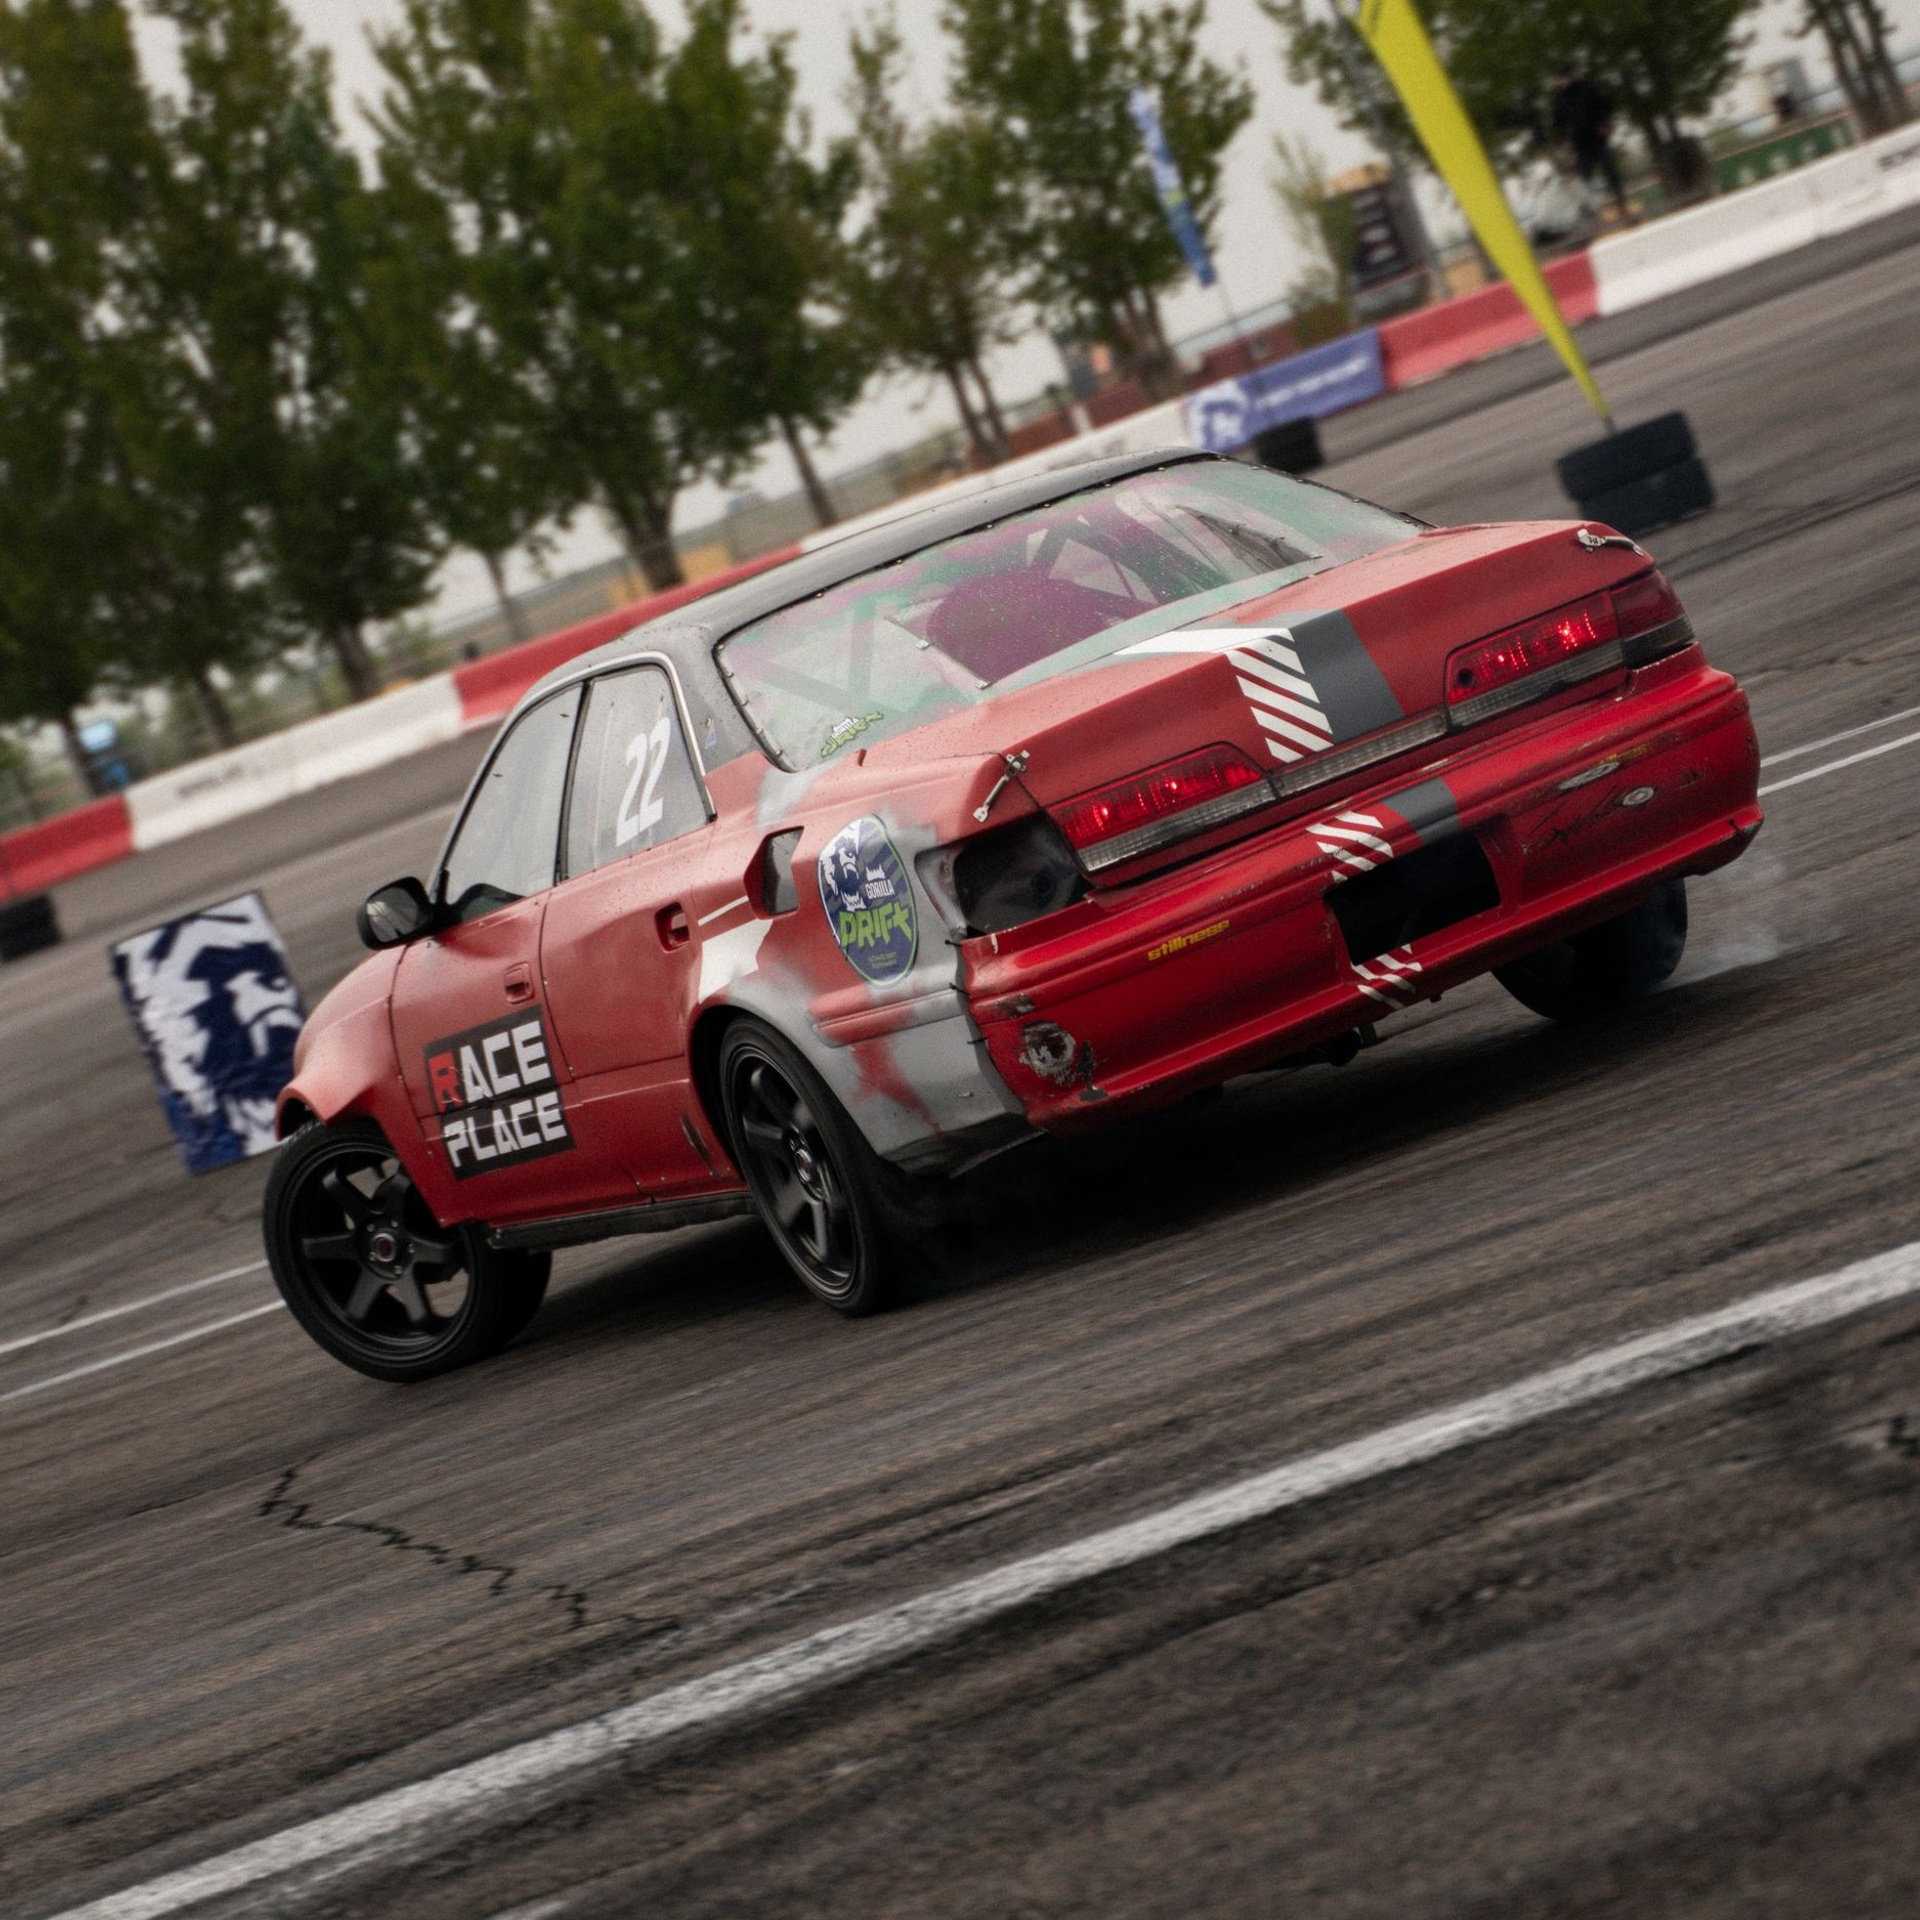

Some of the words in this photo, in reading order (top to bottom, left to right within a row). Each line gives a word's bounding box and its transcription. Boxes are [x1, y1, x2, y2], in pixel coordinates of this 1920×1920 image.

[616, 717, 671, 847] 22
[839, 902, 912, 948] DRIFT
[865, 879, 895, 899] GORILLA
[429, 1020, 551, 1112] RACE
[443, 1091, 568, 1168] PLACE
